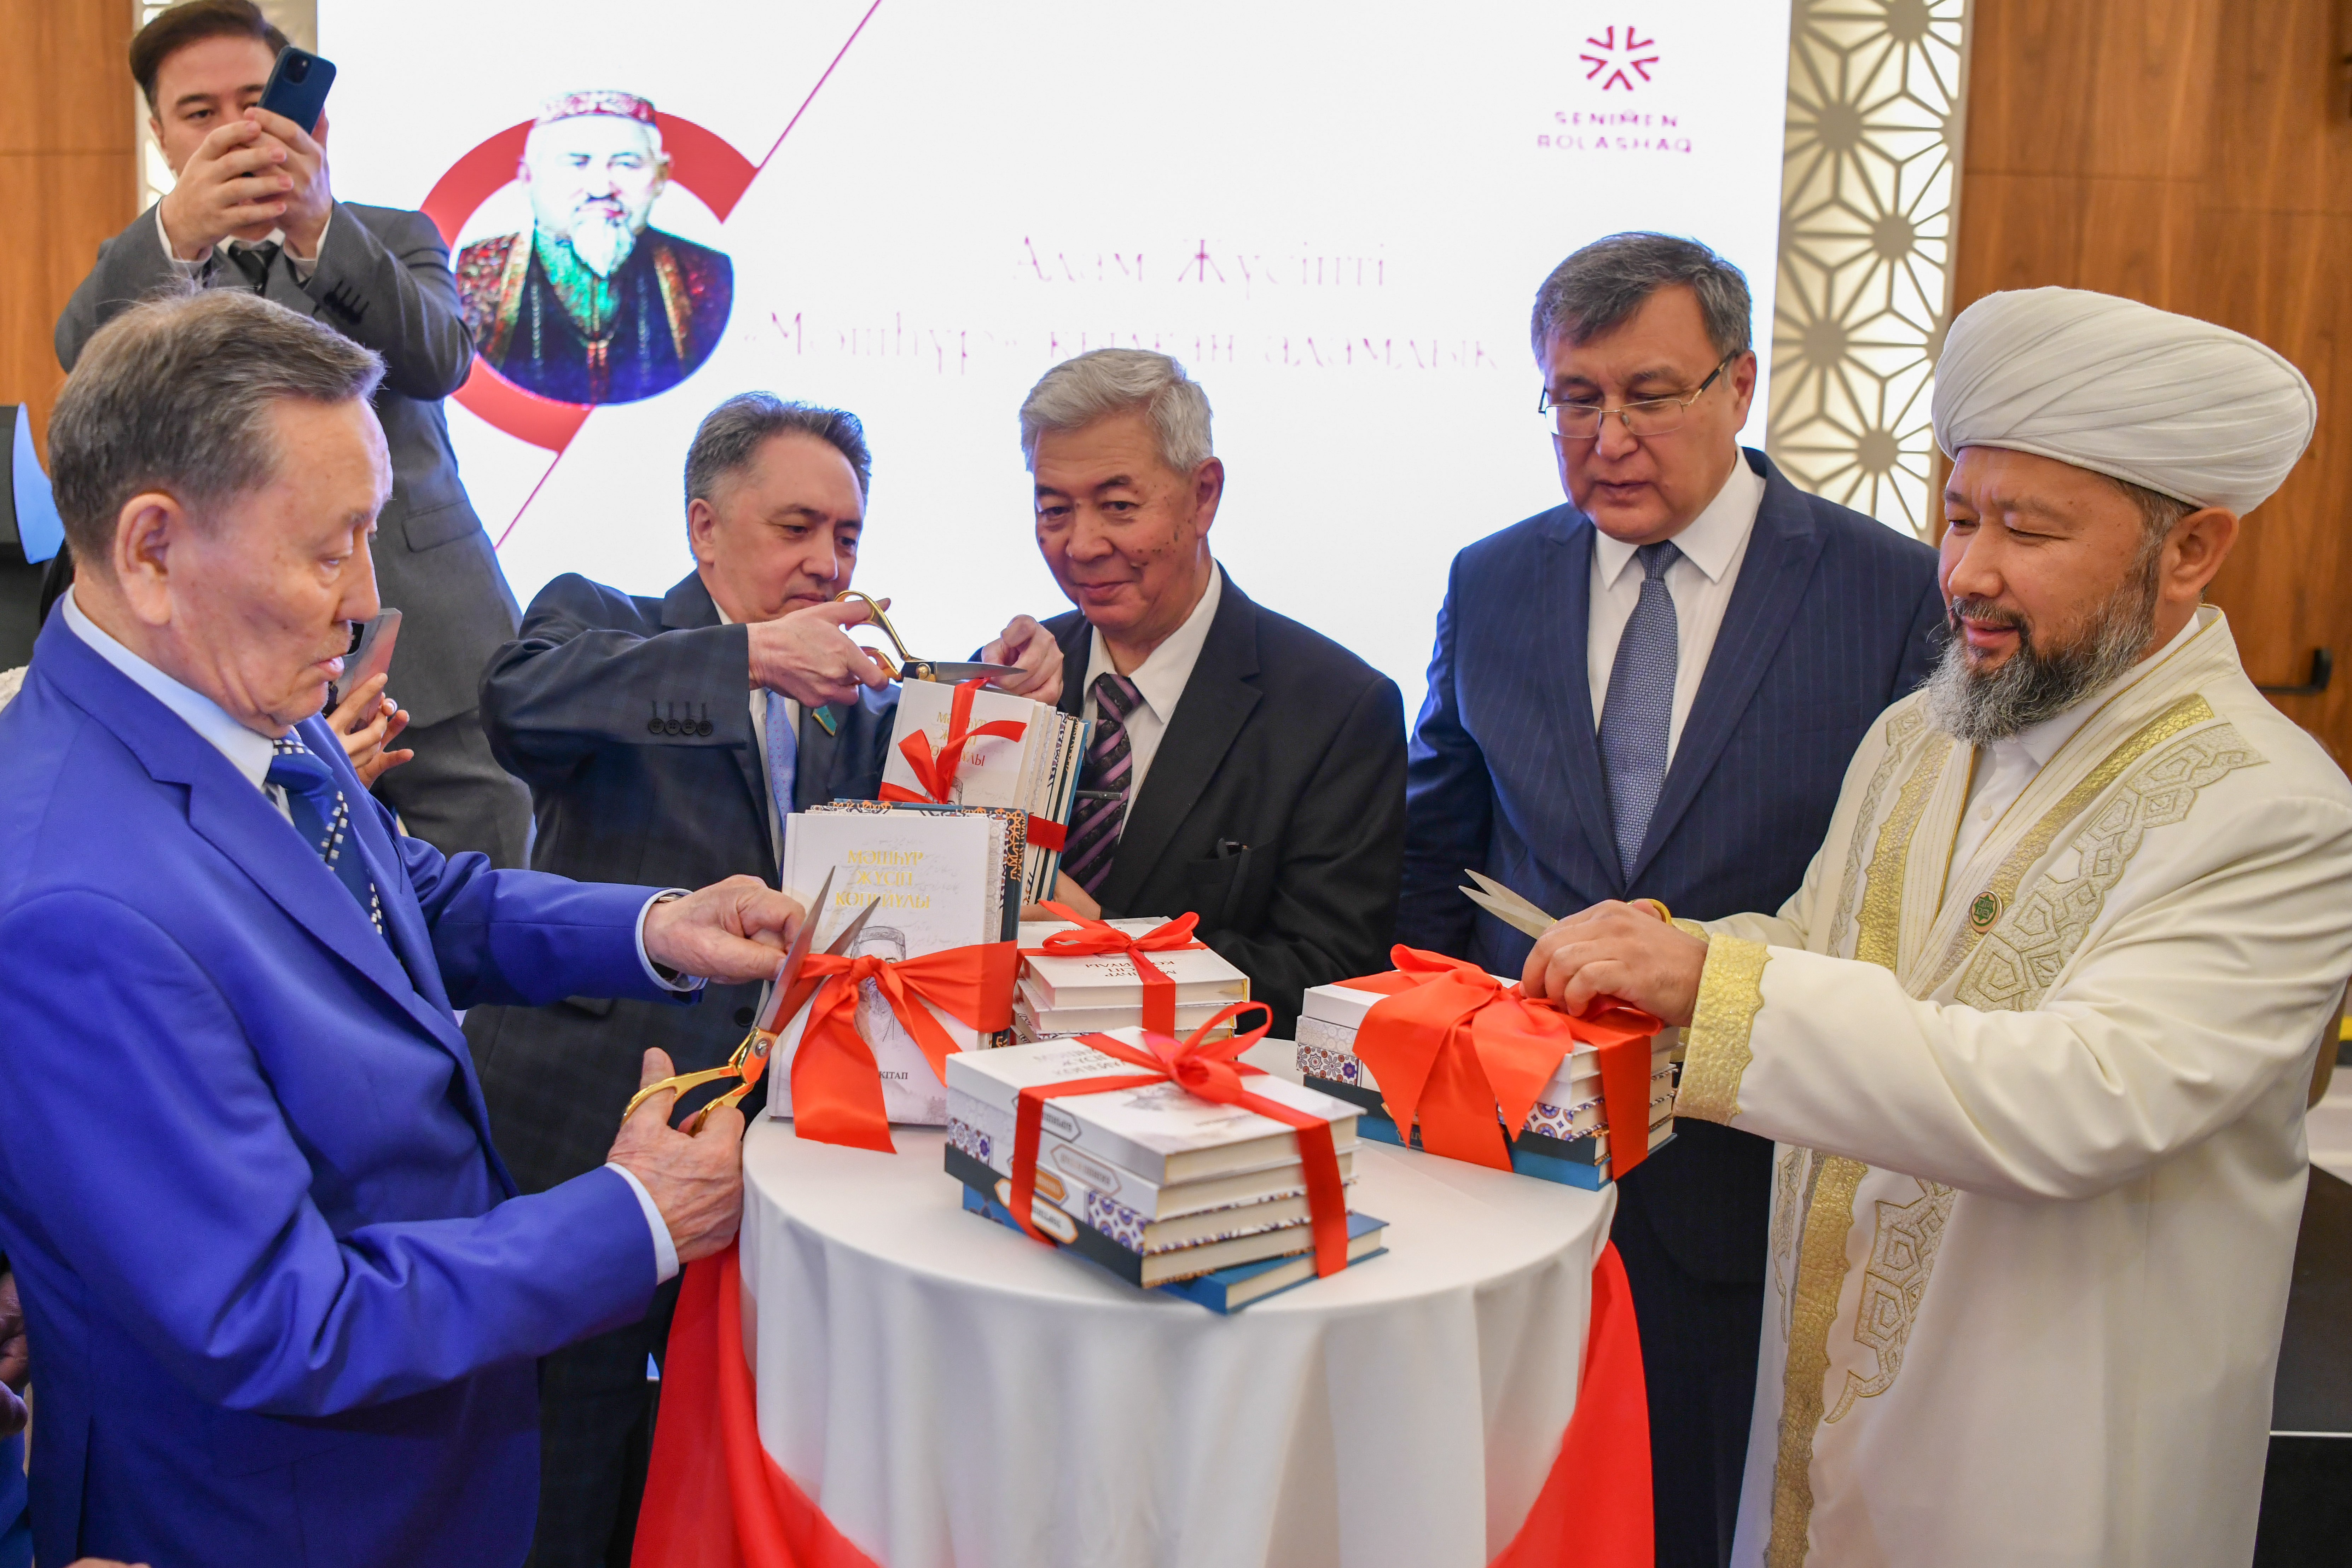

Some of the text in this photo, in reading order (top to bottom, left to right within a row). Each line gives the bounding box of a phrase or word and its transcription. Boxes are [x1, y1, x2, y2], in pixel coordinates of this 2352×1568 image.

[848, 850, 923, 865] МӘШҺҮР
[856, 870, 912, 886] ЖҮСІП
[879, 1071, 908, 1079] КІТАП
